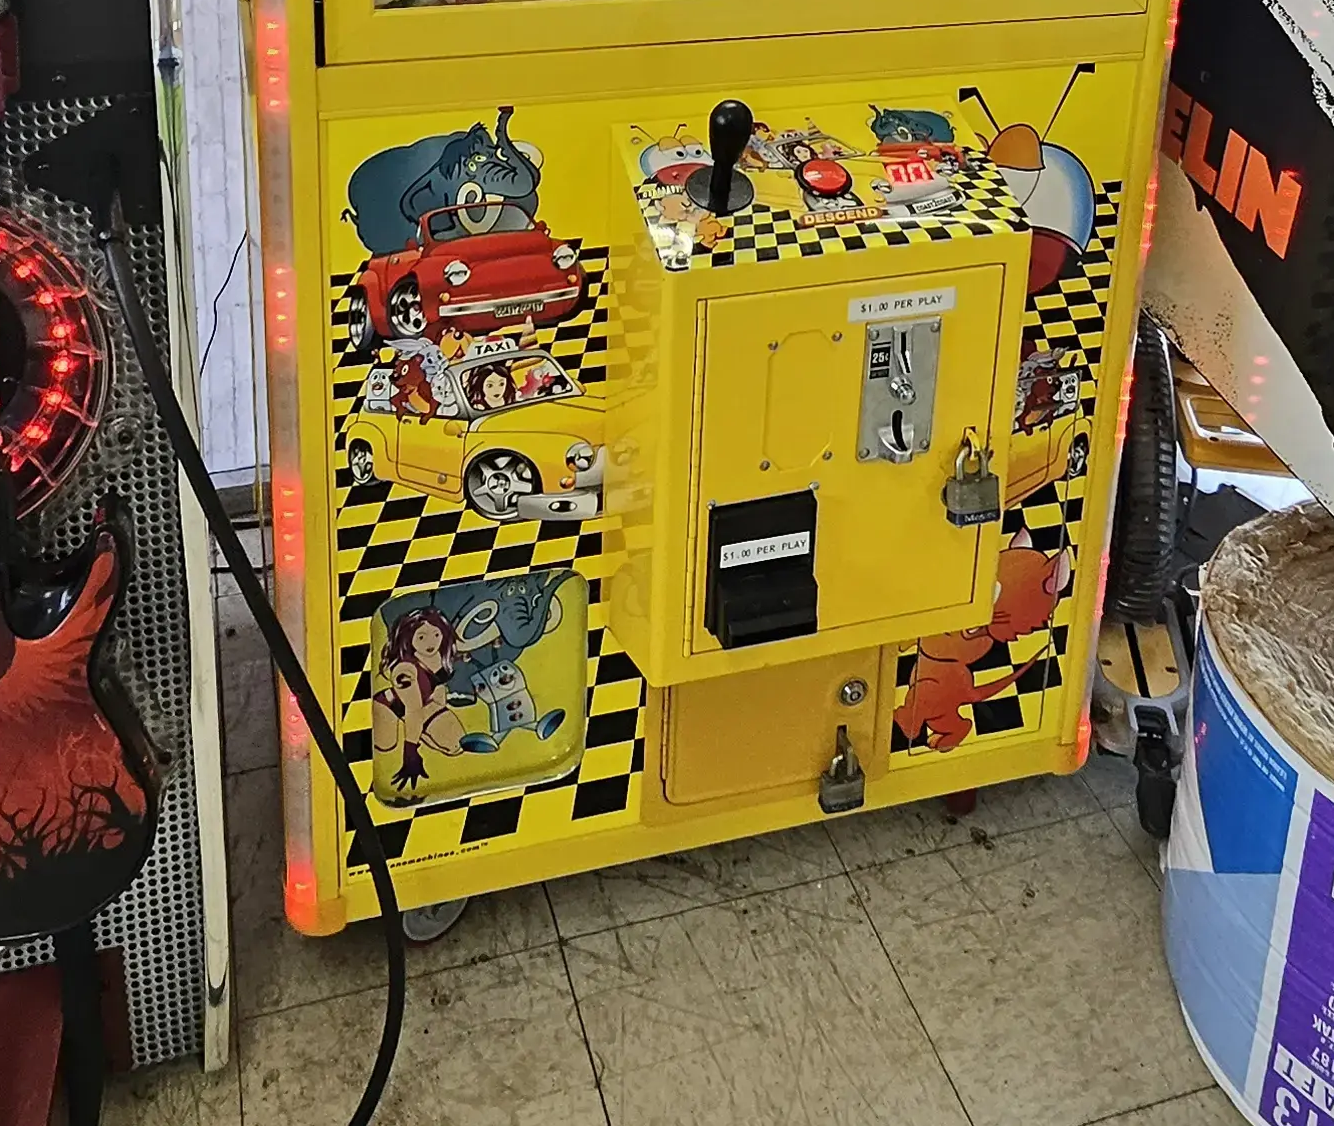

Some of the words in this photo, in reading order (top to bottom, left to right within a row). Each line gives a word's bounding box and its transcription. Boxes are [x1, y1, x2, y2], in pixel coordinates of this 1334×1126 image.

[1161, 82, 1302, 260] ELIN
[916, 194, 955, 212] COAST2COAST
[804, 208, 878, 225] DESCEND
[860, 302, 888, 313] $1.00
[894, 298, 913, 308] PER
[918, 295, 943, 306] PLAY
[475, 342, 511, 354] TAXI
[872, 352, 889, 363] 25¢
[723, 549, 751, 561] $1.00
[757, 545, 776, 555] PER
[782, 539, 806, 551] PLAY
